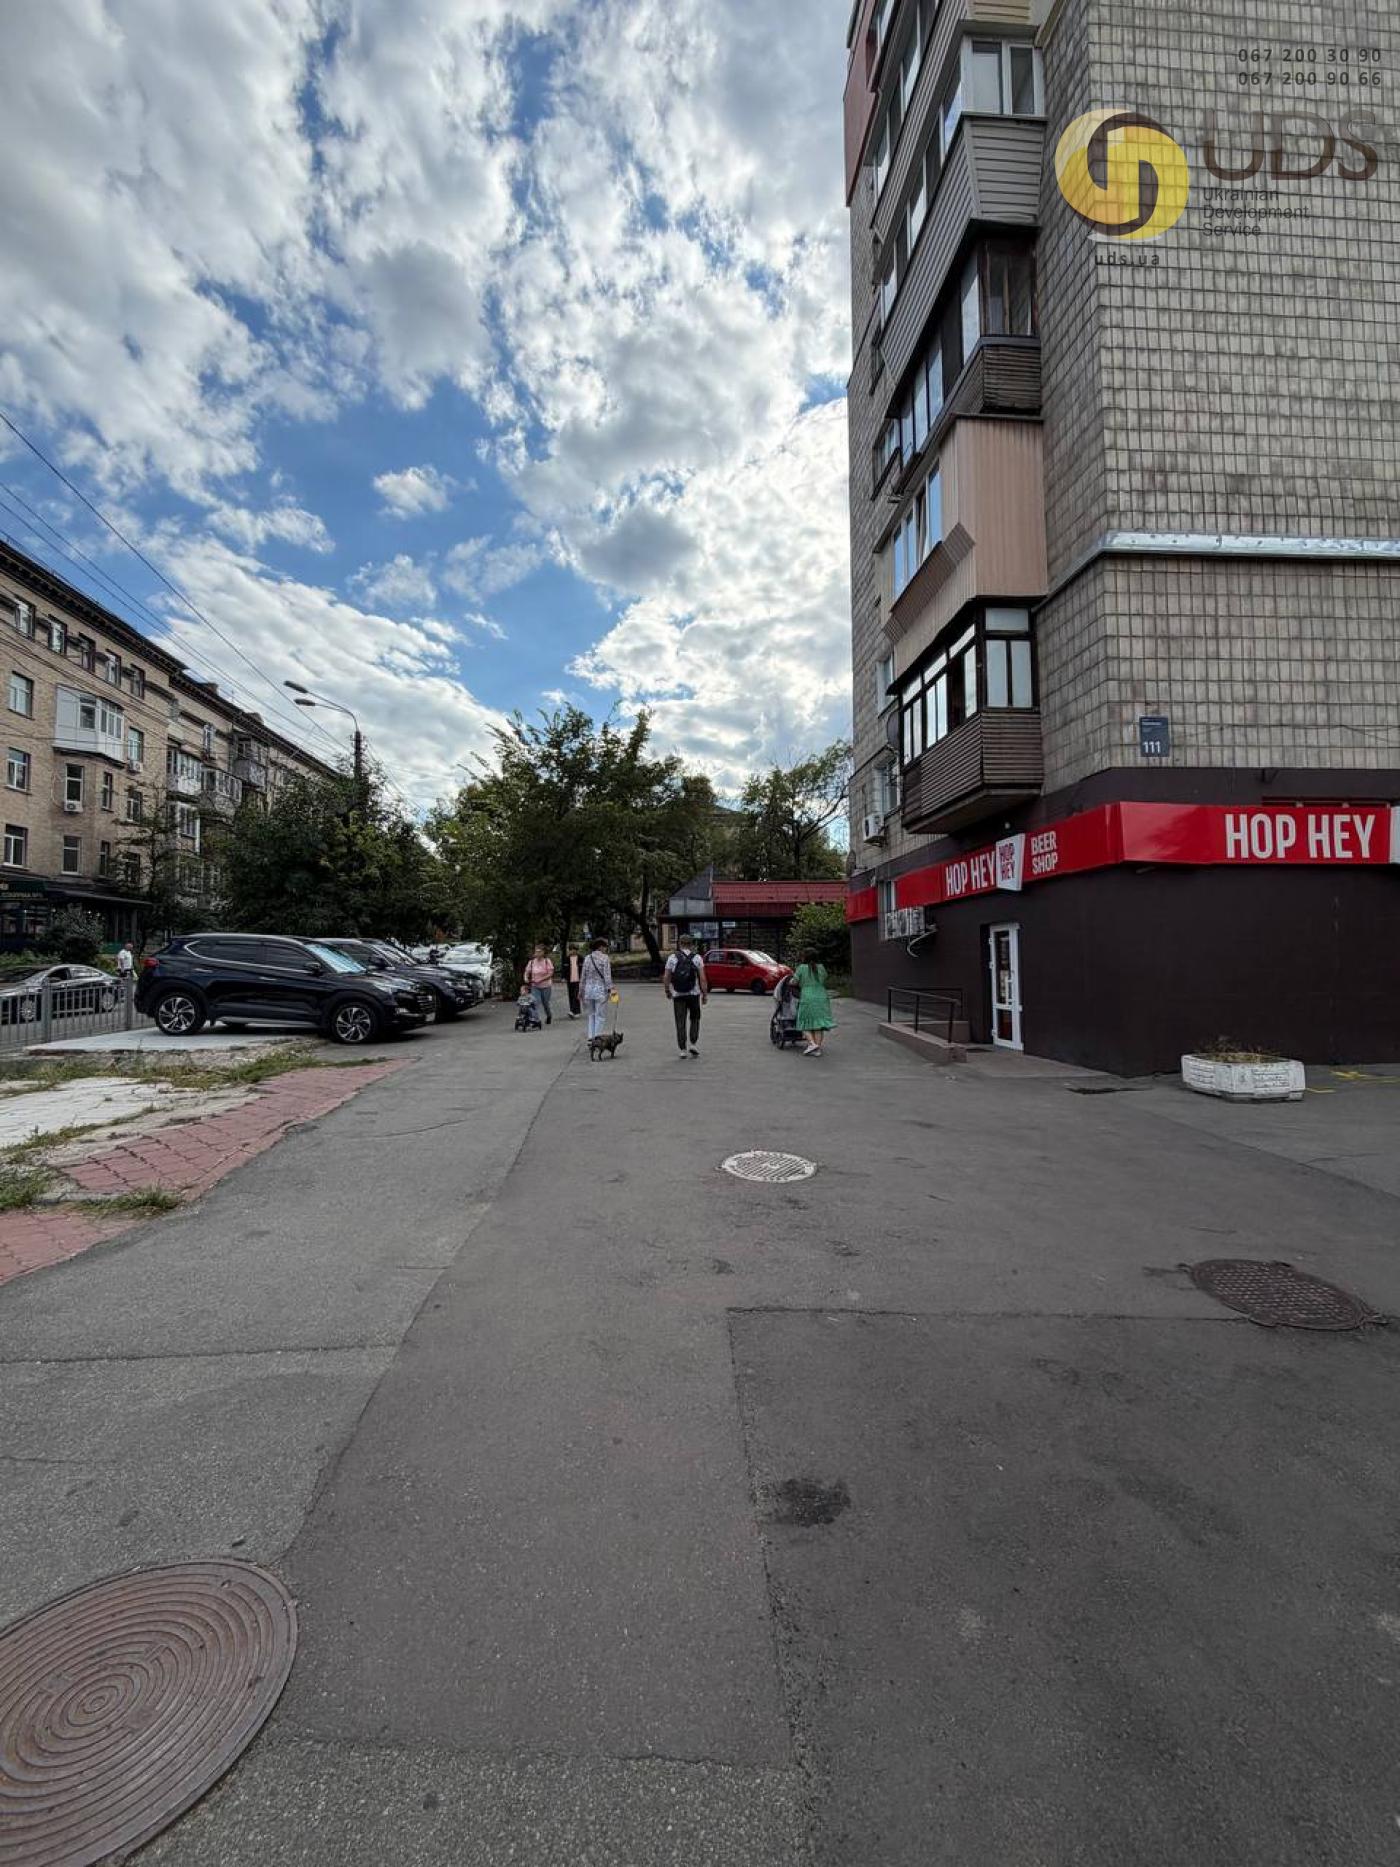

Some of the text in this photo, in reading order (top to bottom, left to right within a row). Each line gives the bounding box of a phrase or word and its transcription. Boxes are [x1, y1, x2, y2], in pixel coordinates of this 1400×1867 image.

[1031, 831, 1057, 856] BEER
[1225, 813, 1375, 859] HOP HEY
[1000, 843, 1015, 861] HOP
[1032, 852, 1058, 875] SHOP
[945, 851, 996, 896] HOP HEY
[1000, 861, 1015, 881] HEY
